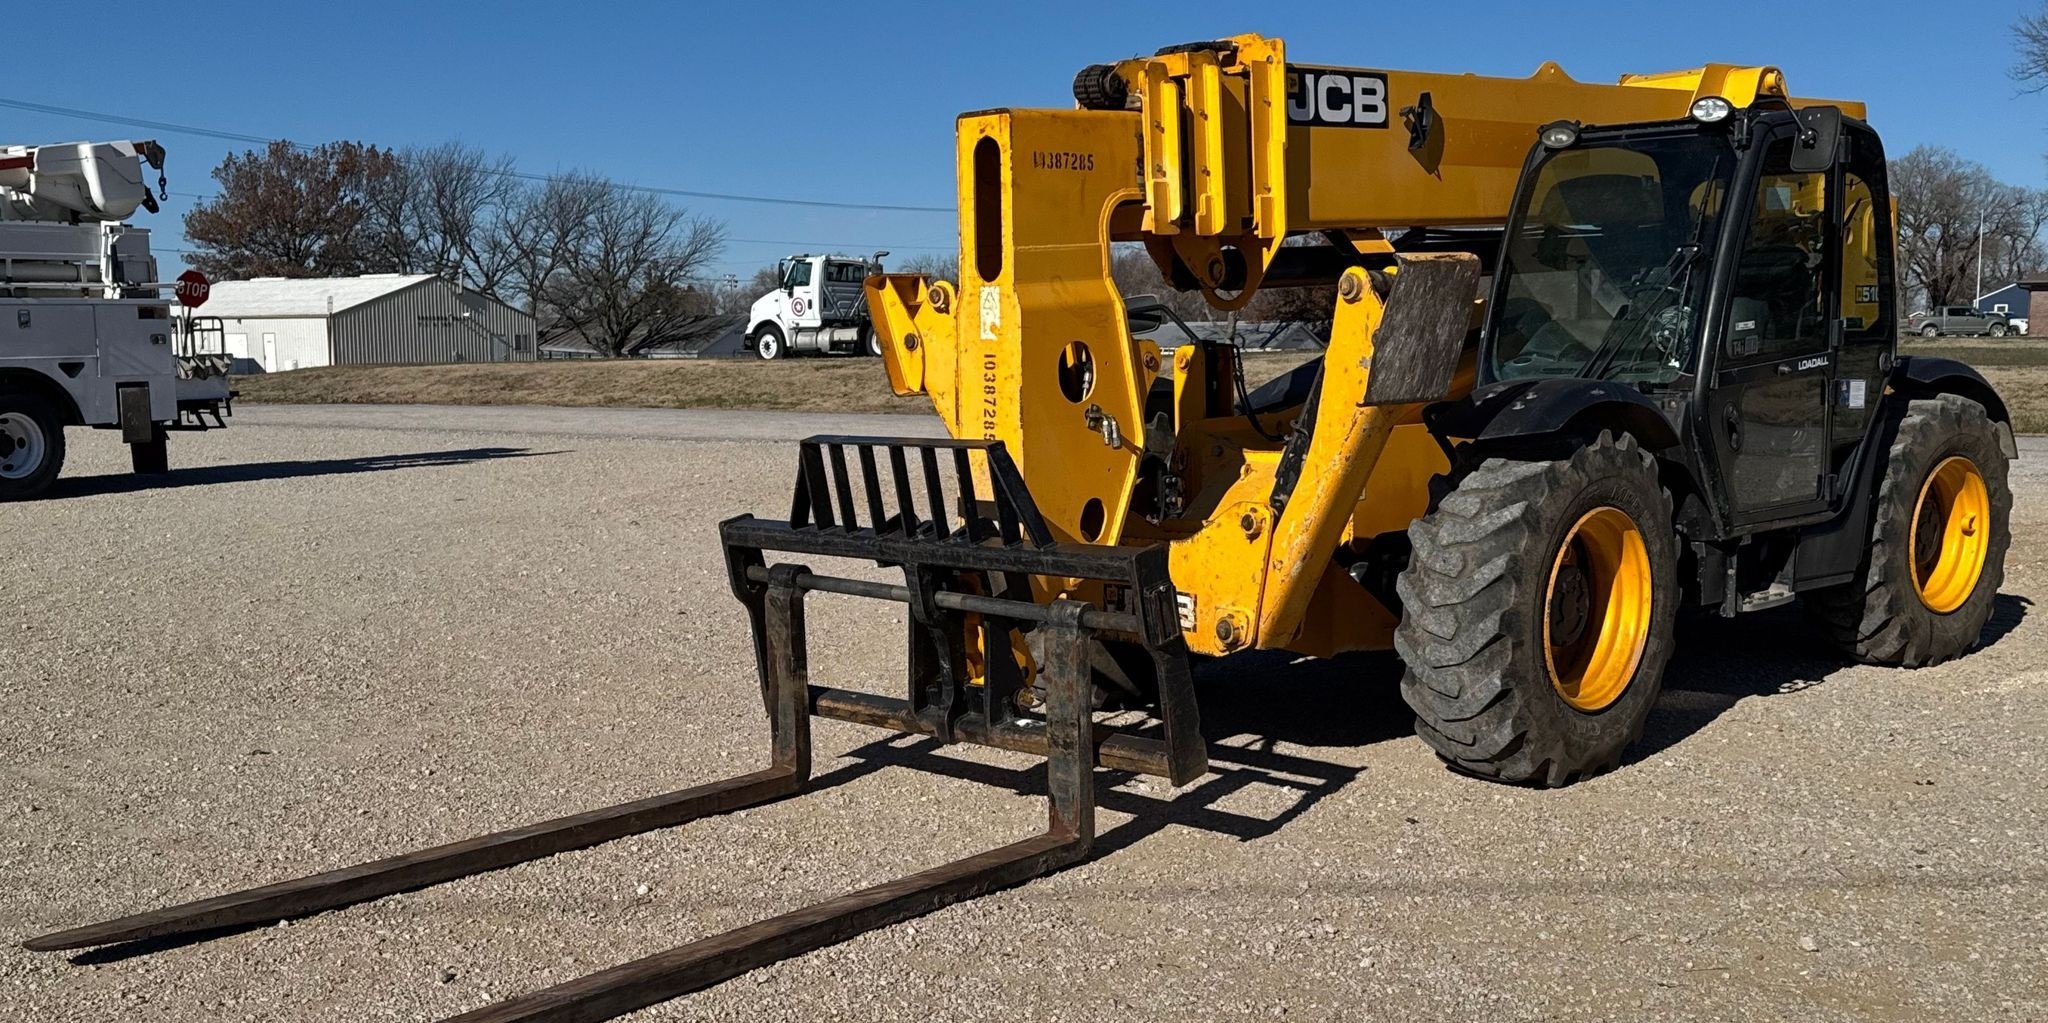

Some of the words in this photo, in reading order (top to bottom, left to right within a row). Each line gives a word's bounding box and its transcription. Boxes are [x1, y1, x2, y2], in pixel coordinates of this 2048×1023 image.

[1288, 73, 1387, 124] JCB
[1798, 355, 1829, 371] LOADALL
[983, 353, 997, 441] 10387285
